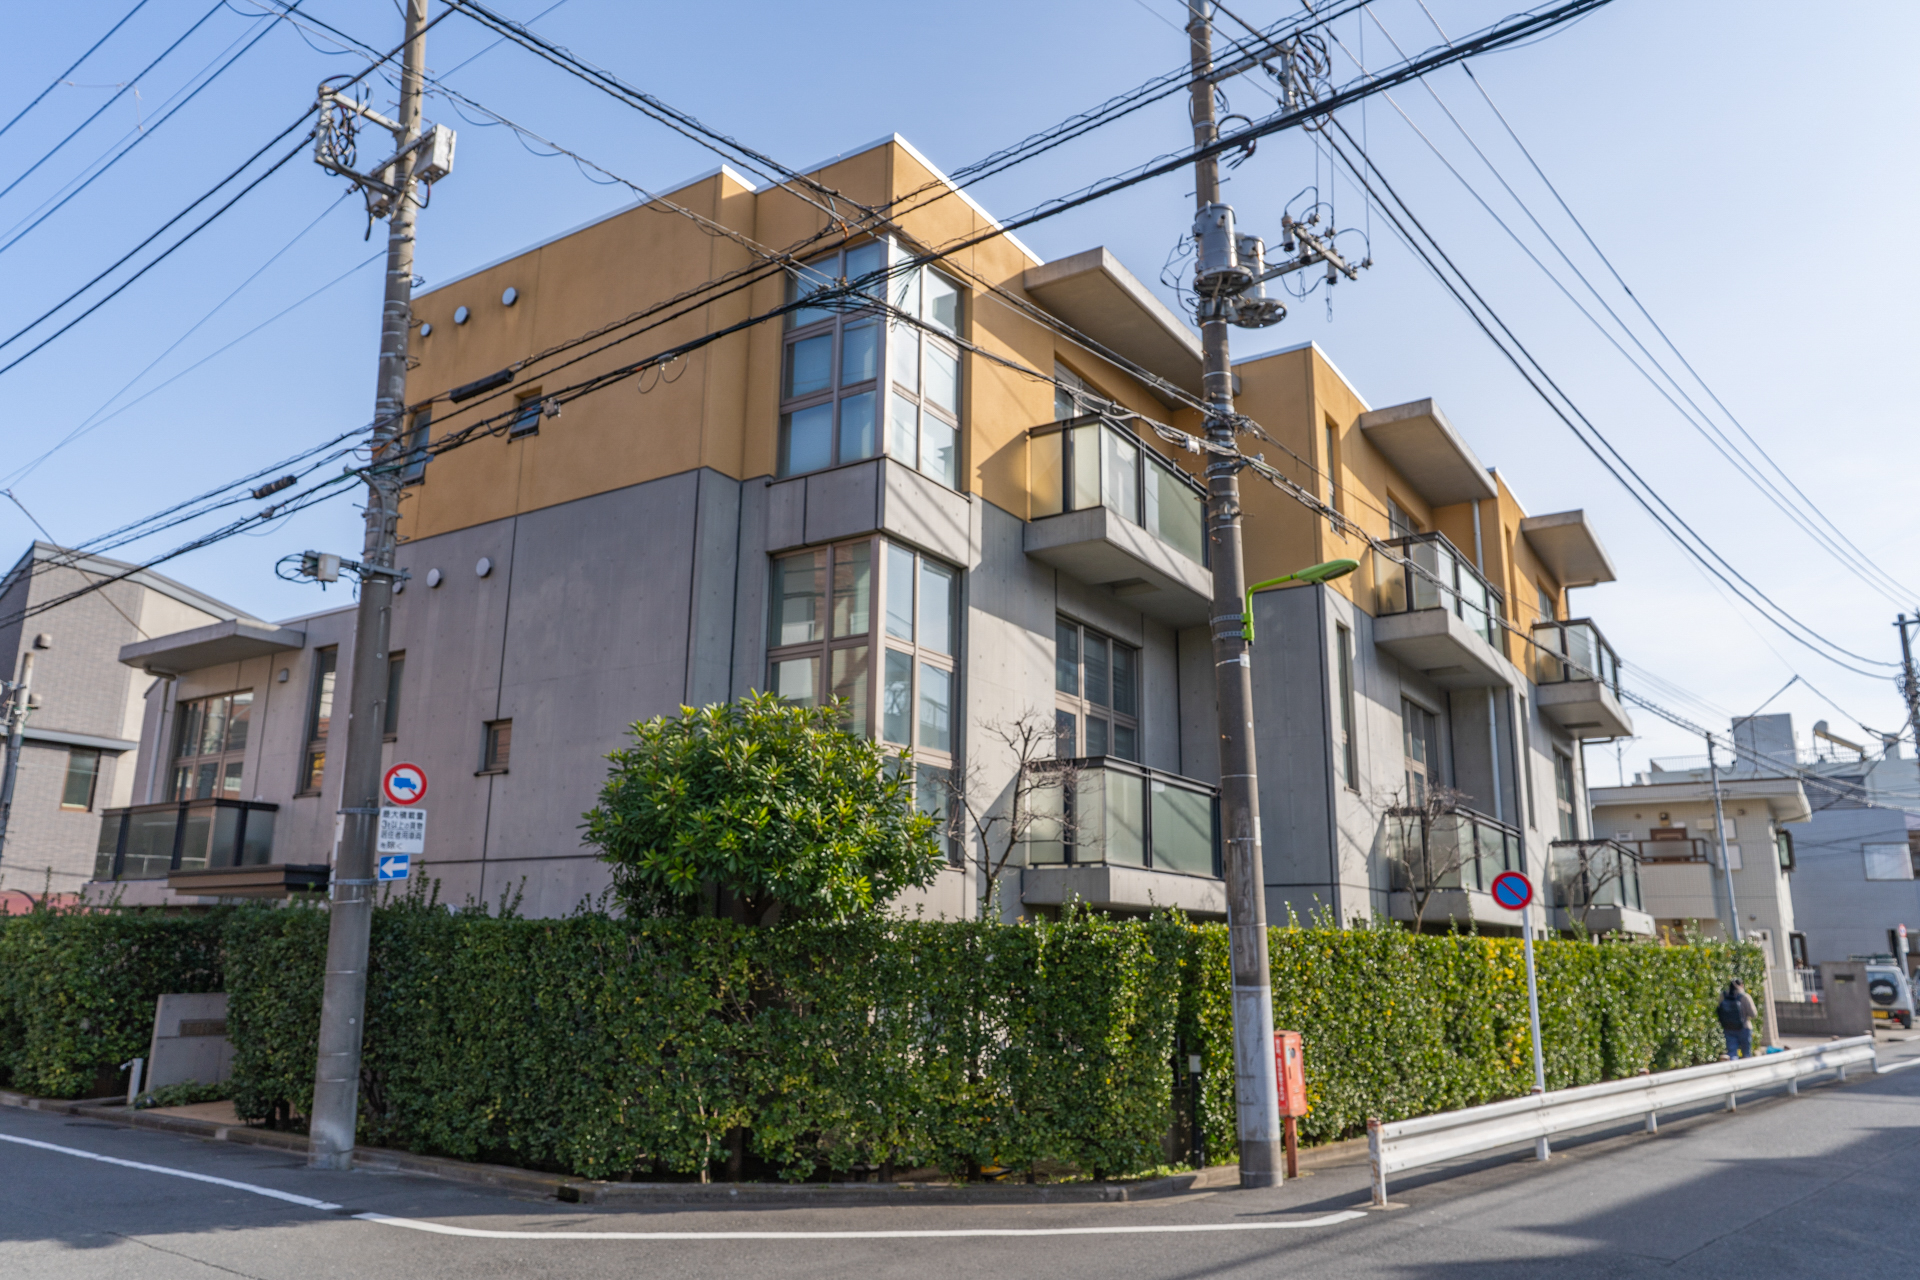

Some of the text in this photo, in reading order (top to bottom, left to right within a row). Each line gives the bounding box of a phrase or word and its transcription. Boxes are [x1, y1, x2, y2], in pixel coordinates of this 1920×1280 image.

[383, 810, 423, 820] 最大積載量
[380, 841, 403, 850] を除く
